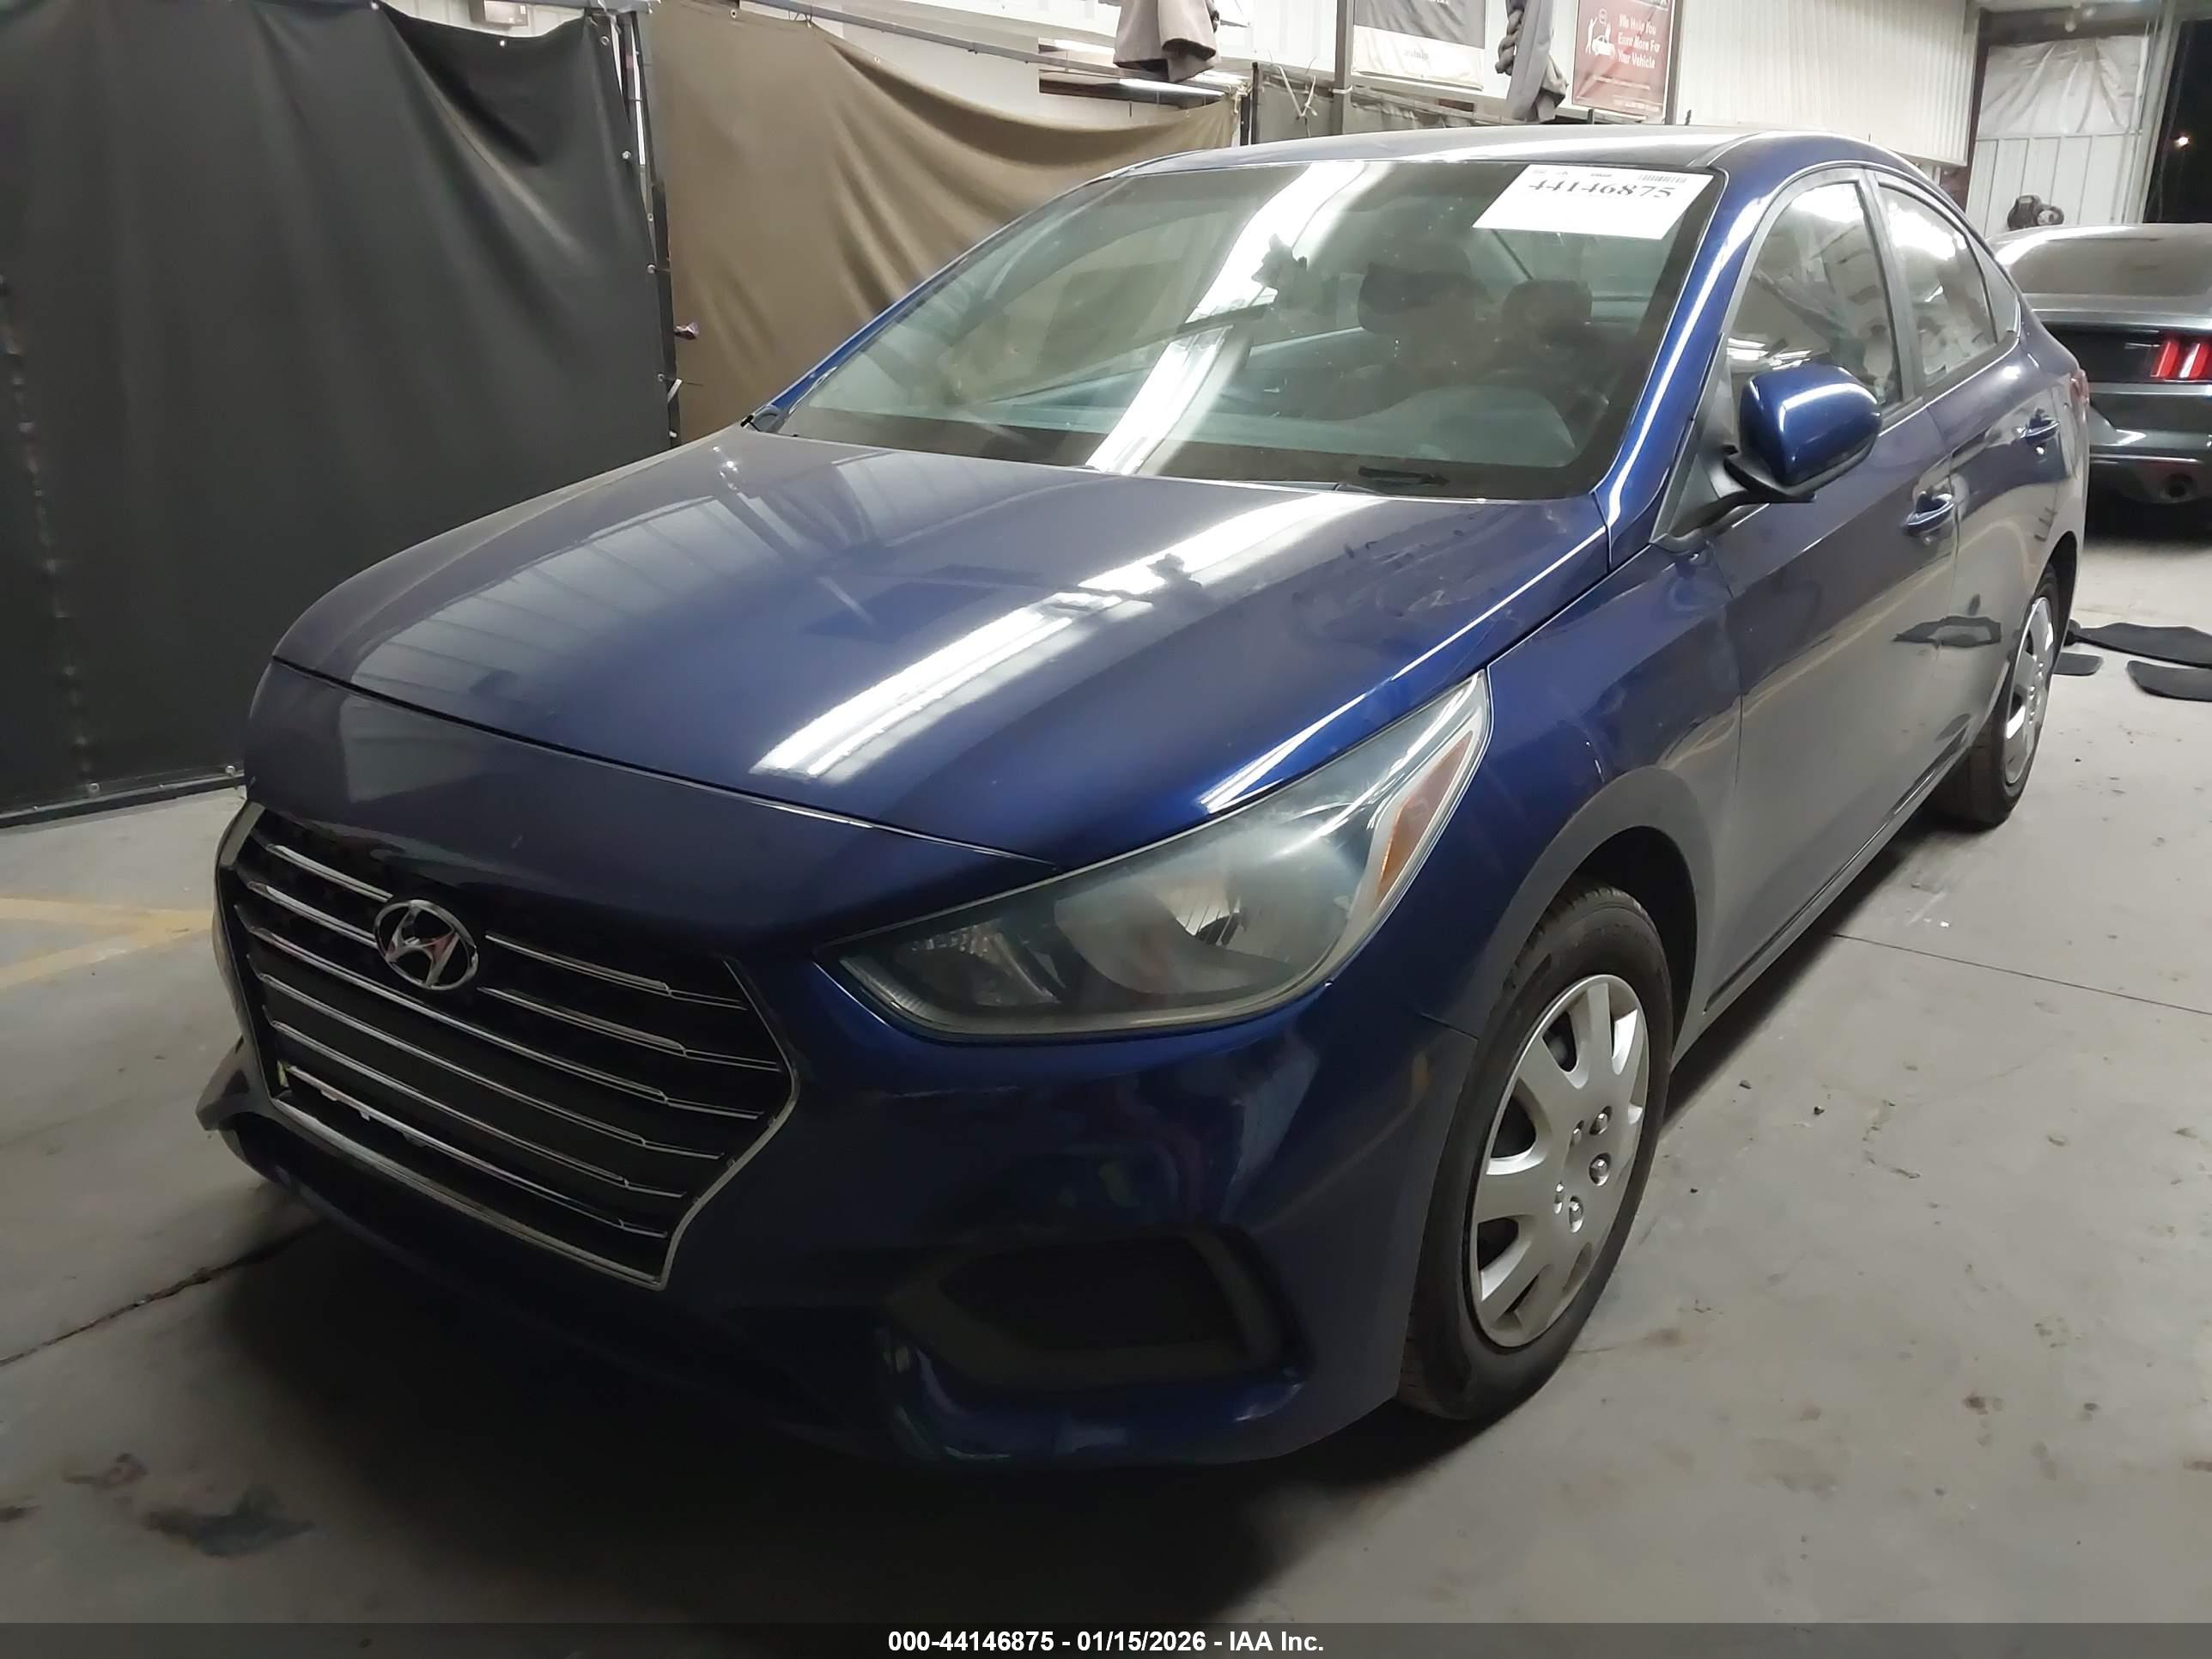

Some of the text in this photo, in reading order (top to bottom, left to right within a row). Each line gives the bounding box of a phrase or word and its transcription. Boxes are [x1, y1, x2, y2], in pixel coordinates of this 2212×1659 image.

[1645, 21, 1656, 35] You
[1618, 31, 1633, 46] Earn
[1633, 34, 1650, 51] More
[1618, 49, 1656, 70] Your Vehicle
[1528, 179, 1675, 197] 44146875
